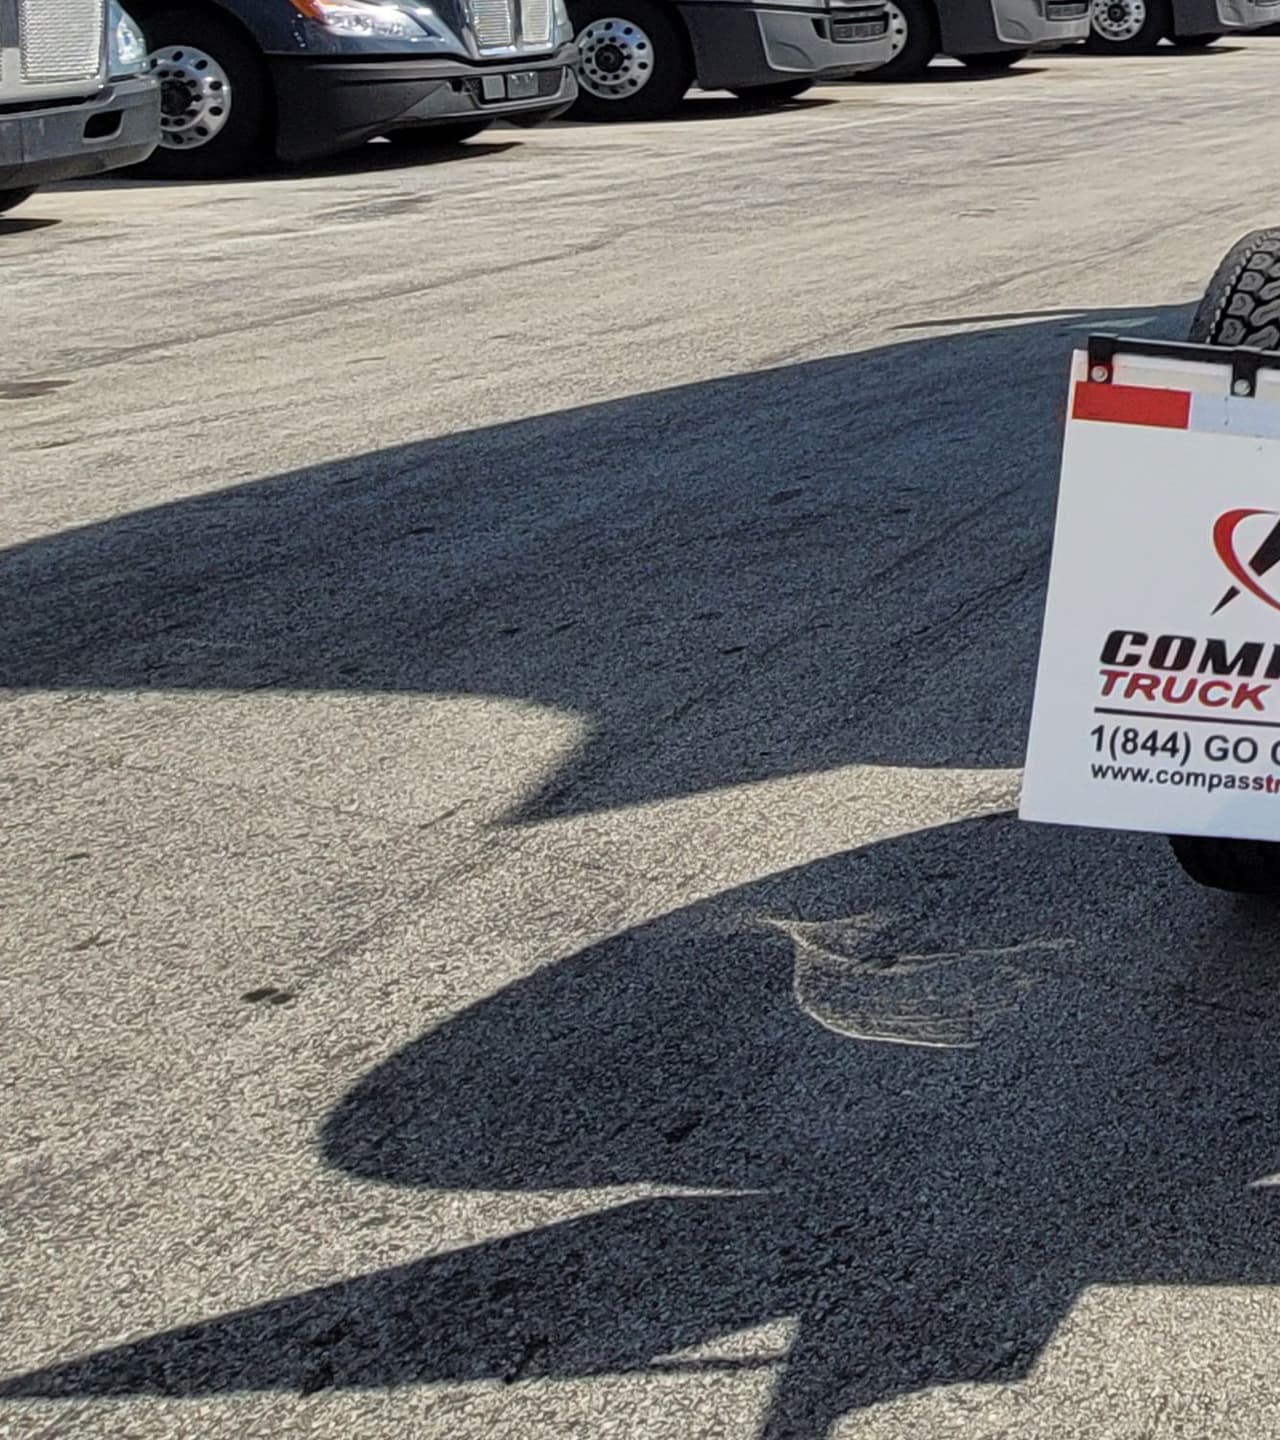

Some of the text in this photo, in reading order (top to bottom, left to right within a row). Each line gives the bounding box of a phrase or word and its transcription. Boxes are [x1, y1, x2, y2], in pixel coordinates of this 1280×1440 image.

[1100, 669, 1271, 711] TRUCK
[1091, 725, 1191, 767] 1(844)
[1204, 735, 1259, 763] GO
